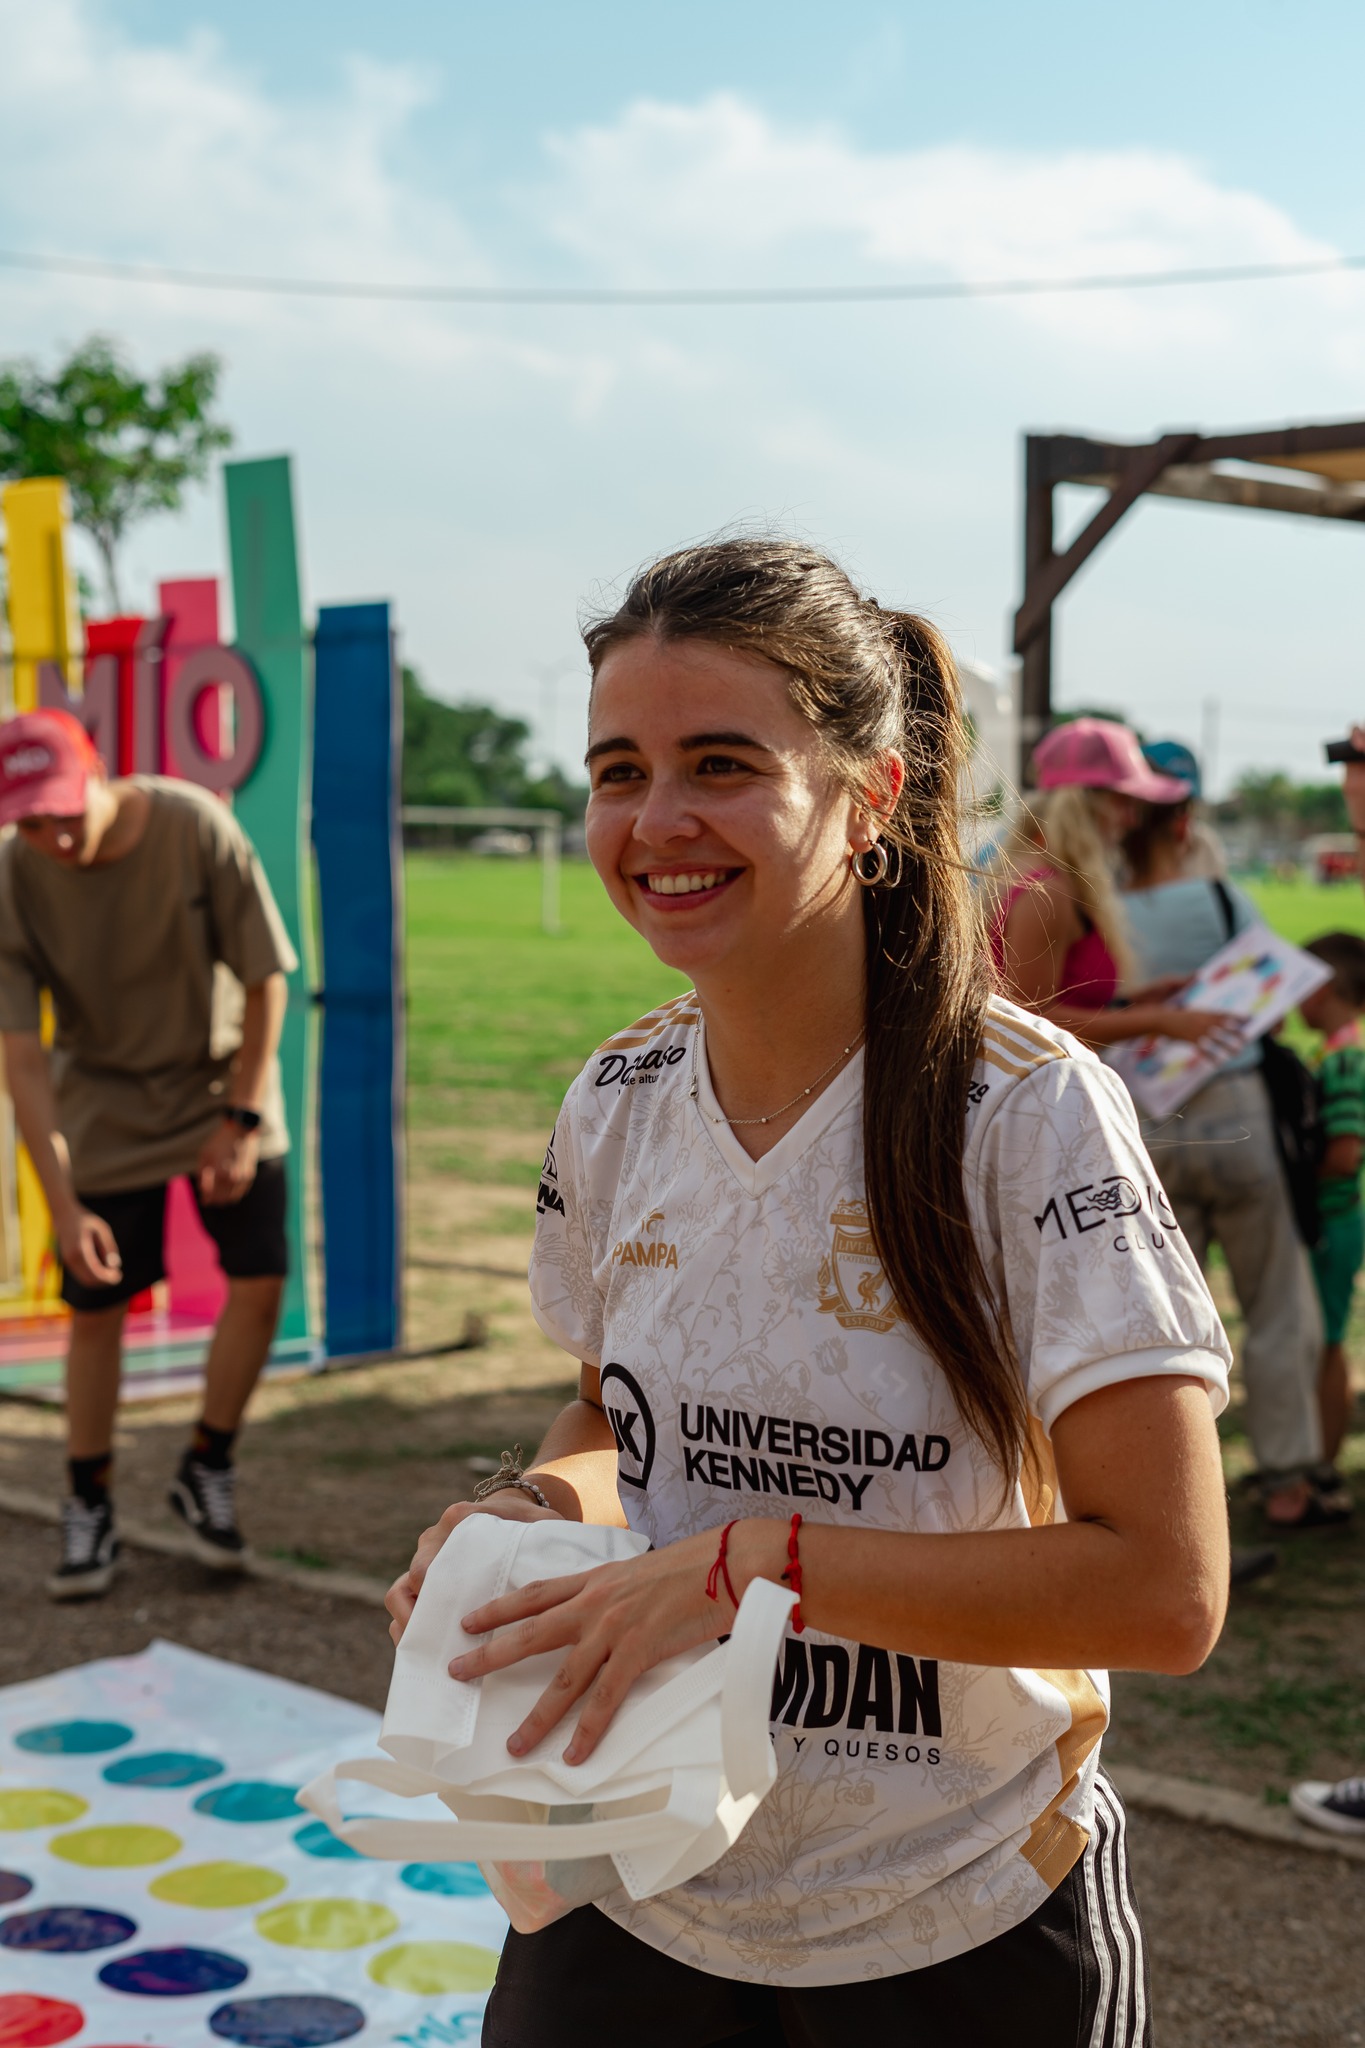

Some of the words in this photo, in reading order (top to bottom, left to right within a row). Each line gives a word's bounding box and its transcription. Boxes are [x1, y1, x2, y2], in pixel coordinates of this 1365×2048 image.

[611, 1240, 679, 1270] PAMPA
[845, 1316, 864, 1326] EST
[680, 1401, 951, 1472] UNIVERSIDAD
[683, 1446, 875, 1511] KENNEDY
[769, 1637, 942, 1738] MDAN
[793, 1737, 806, 1752] Y
[824, 1738, 941, 1765] QUESOS
